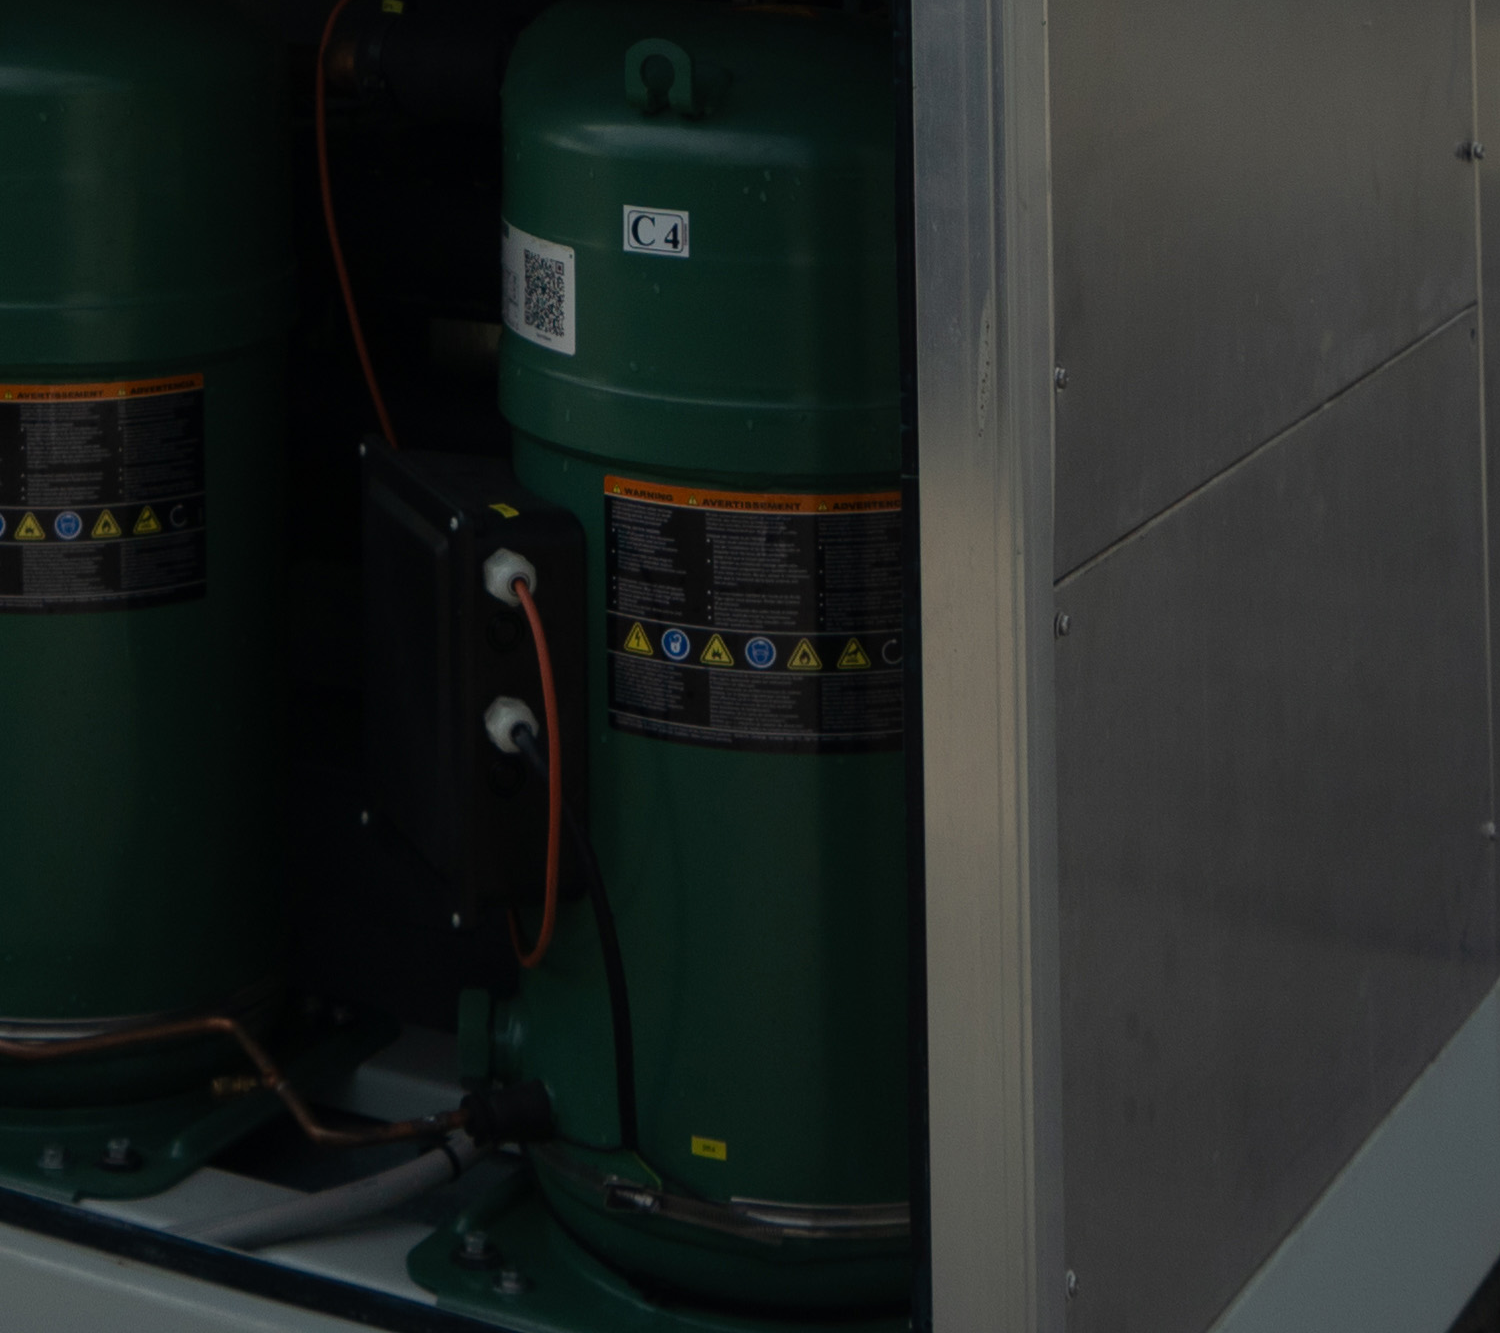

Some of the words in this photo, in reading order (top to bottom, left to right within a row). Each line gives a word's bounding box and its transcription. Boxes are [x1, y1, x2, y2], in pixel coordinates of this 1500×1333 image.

[16, 389, 104, 400] AVERTISSEMENT
[129, 379, 195, 396] ADVERTENCIA
[623, 487, 673, 502] WARNING
[702, 498, 802, 511] AVERTISSEMENT
[832, 499, 902, 511] ADVERTENC
